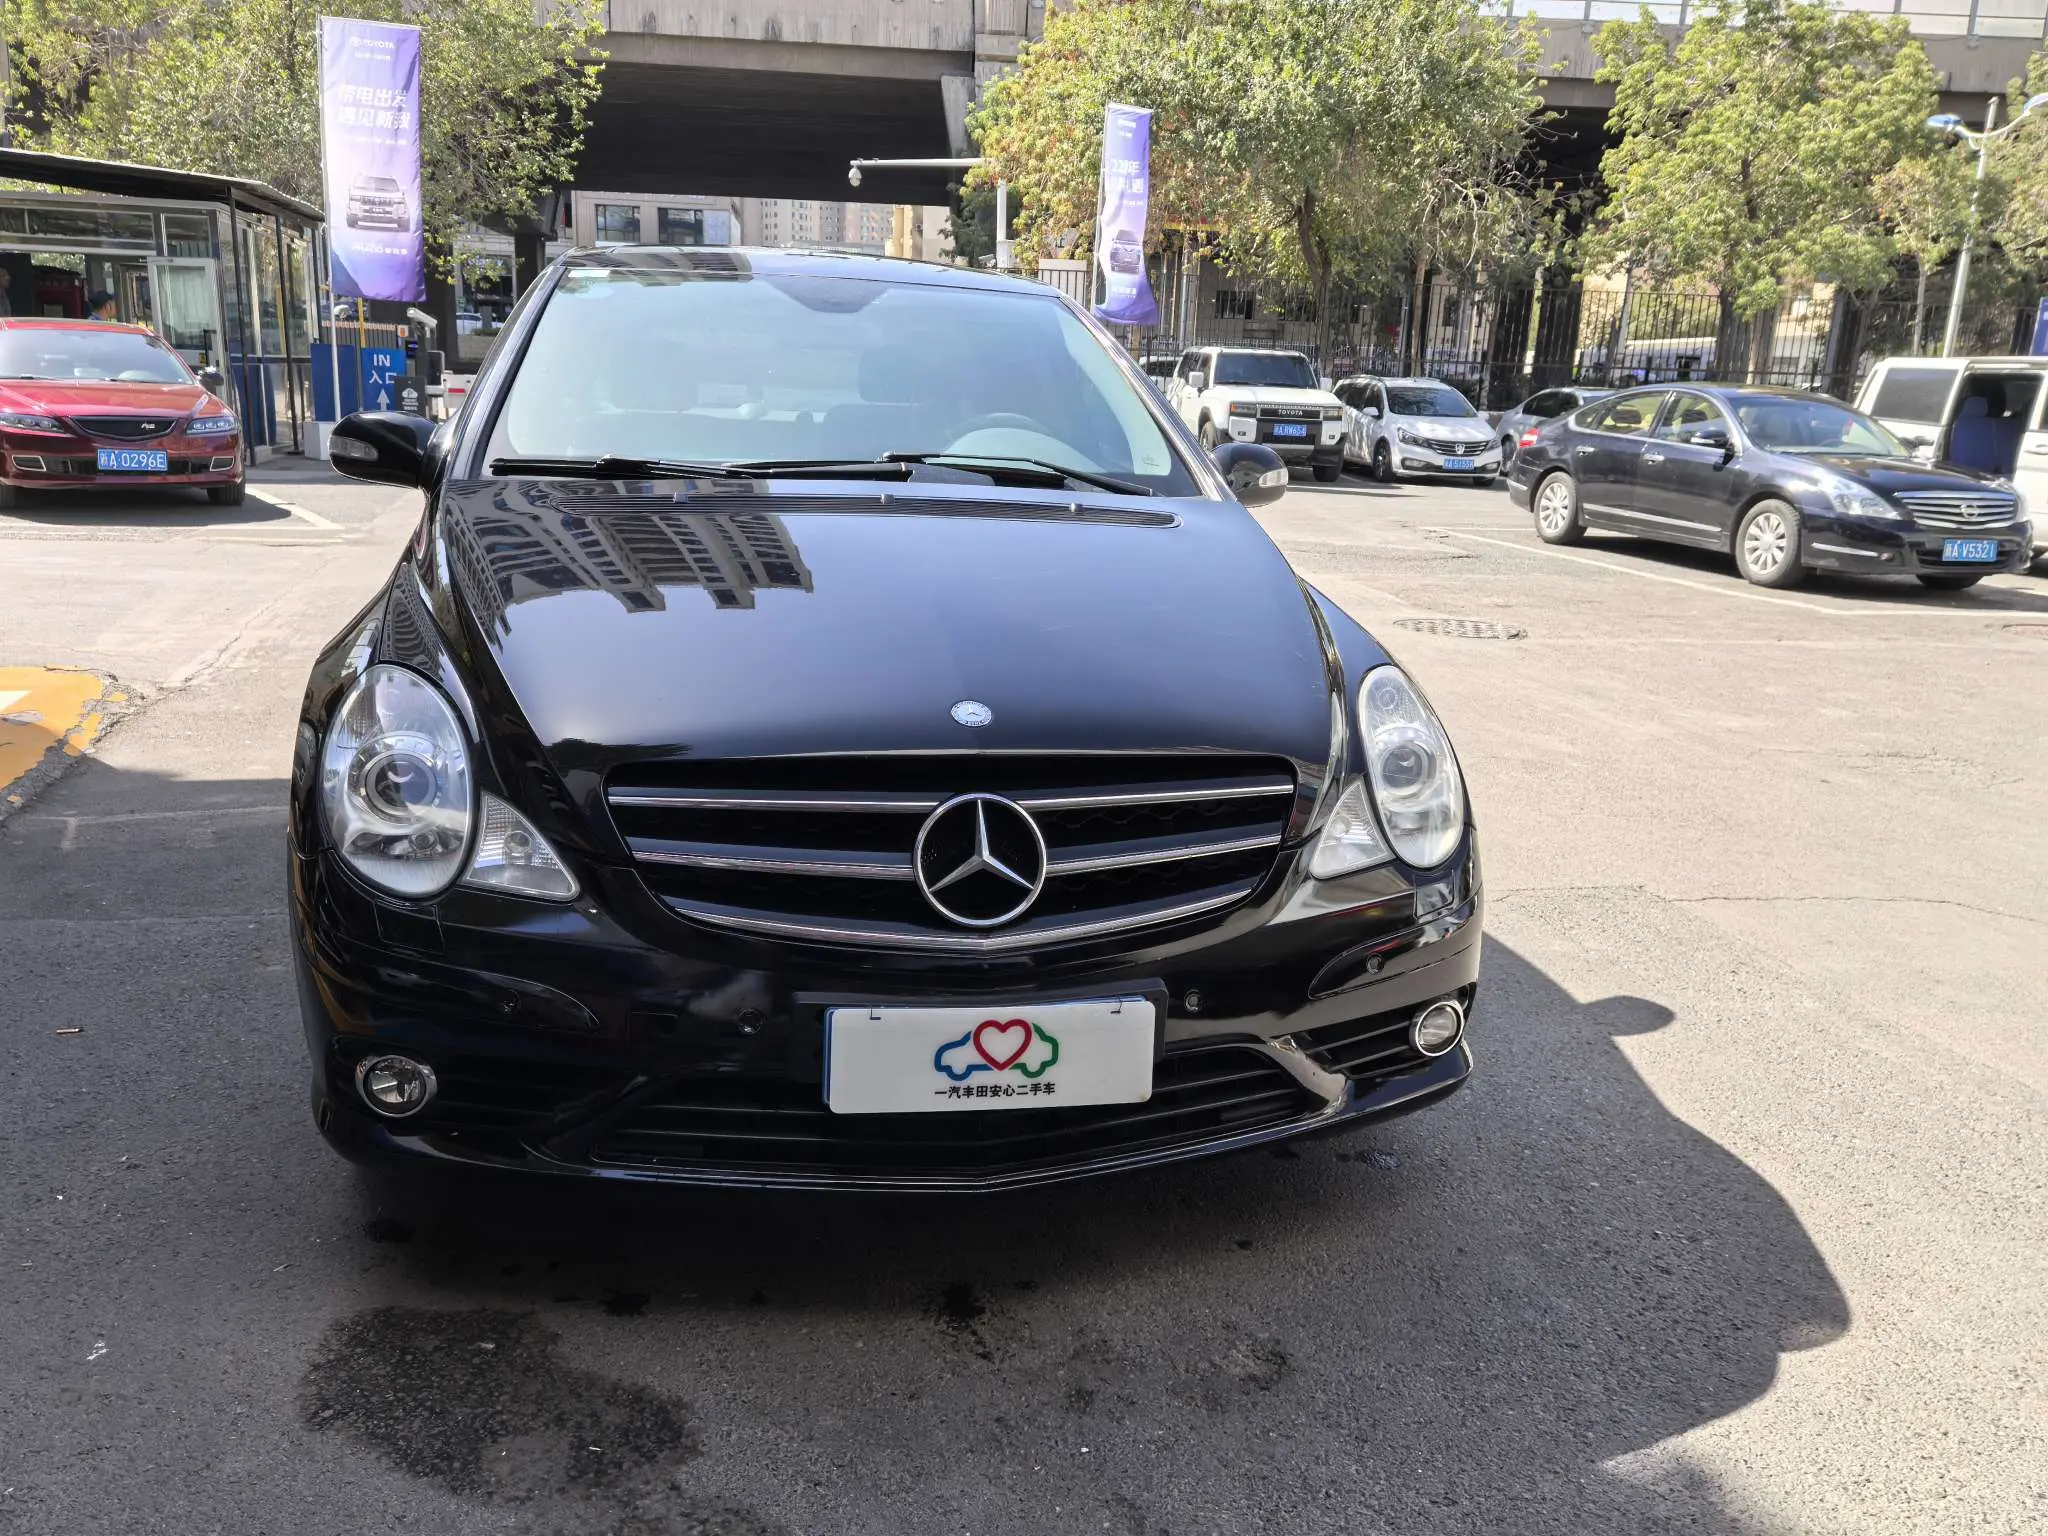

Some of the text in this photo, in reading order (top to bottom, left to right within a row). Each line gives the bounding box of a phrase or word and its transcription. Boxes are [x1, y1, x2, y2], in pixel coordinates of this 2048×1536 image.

[373, 354, 390, 367] IN
[369, 370, 397, 385] 入口
[1944, 543, 1994, 559] A·V5321
[934, 1082, 1056, 1099] 一汽丰田安心二手车
